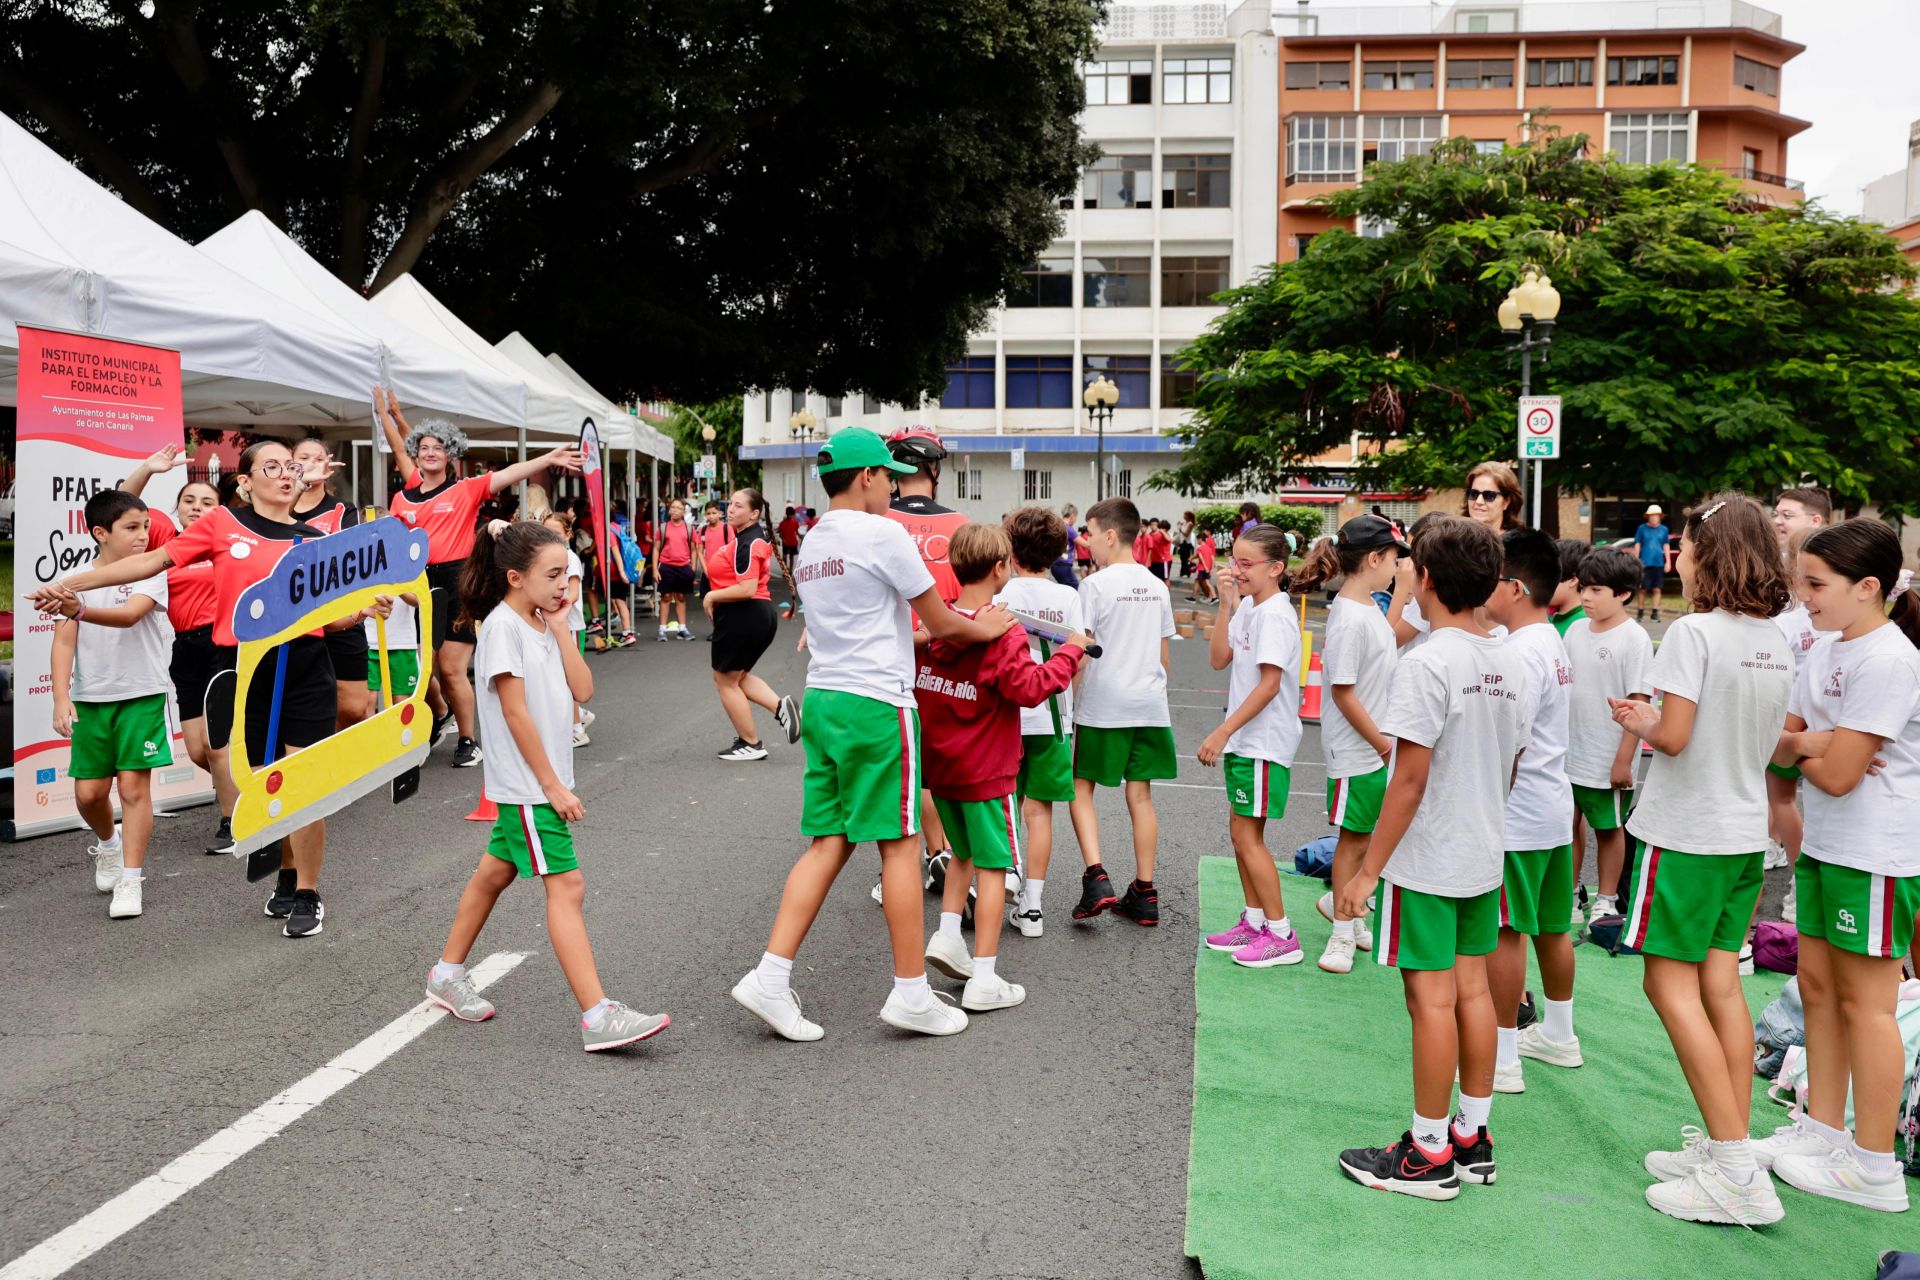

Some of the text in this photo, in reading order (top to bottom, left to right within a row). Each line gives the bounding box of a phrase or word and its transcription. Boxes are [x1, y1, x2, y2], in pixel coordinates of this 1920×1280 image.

[41, 347, 162, 374] INSTITUTO MUNICIPAL
[41, 362, 163, 387] PARA EL EMPLEO Y LA
[71, 380, 138, 398] FORMACIÓN
[52, 405, 154, 423] Ayuntamiento de Las Palmas
[1532, 417, 1548, 426] 30
[76, 419, 134, 431] de Gran Canaria
[289, 538, 388, 605] GUAGUA
[821, 556, 845, 578] RÍOS
[1039, 608, 1064, 624] RÍOS
[1755, 652, 1772, 661] CEIP
[1488, 688, 1504, 697] LOS
